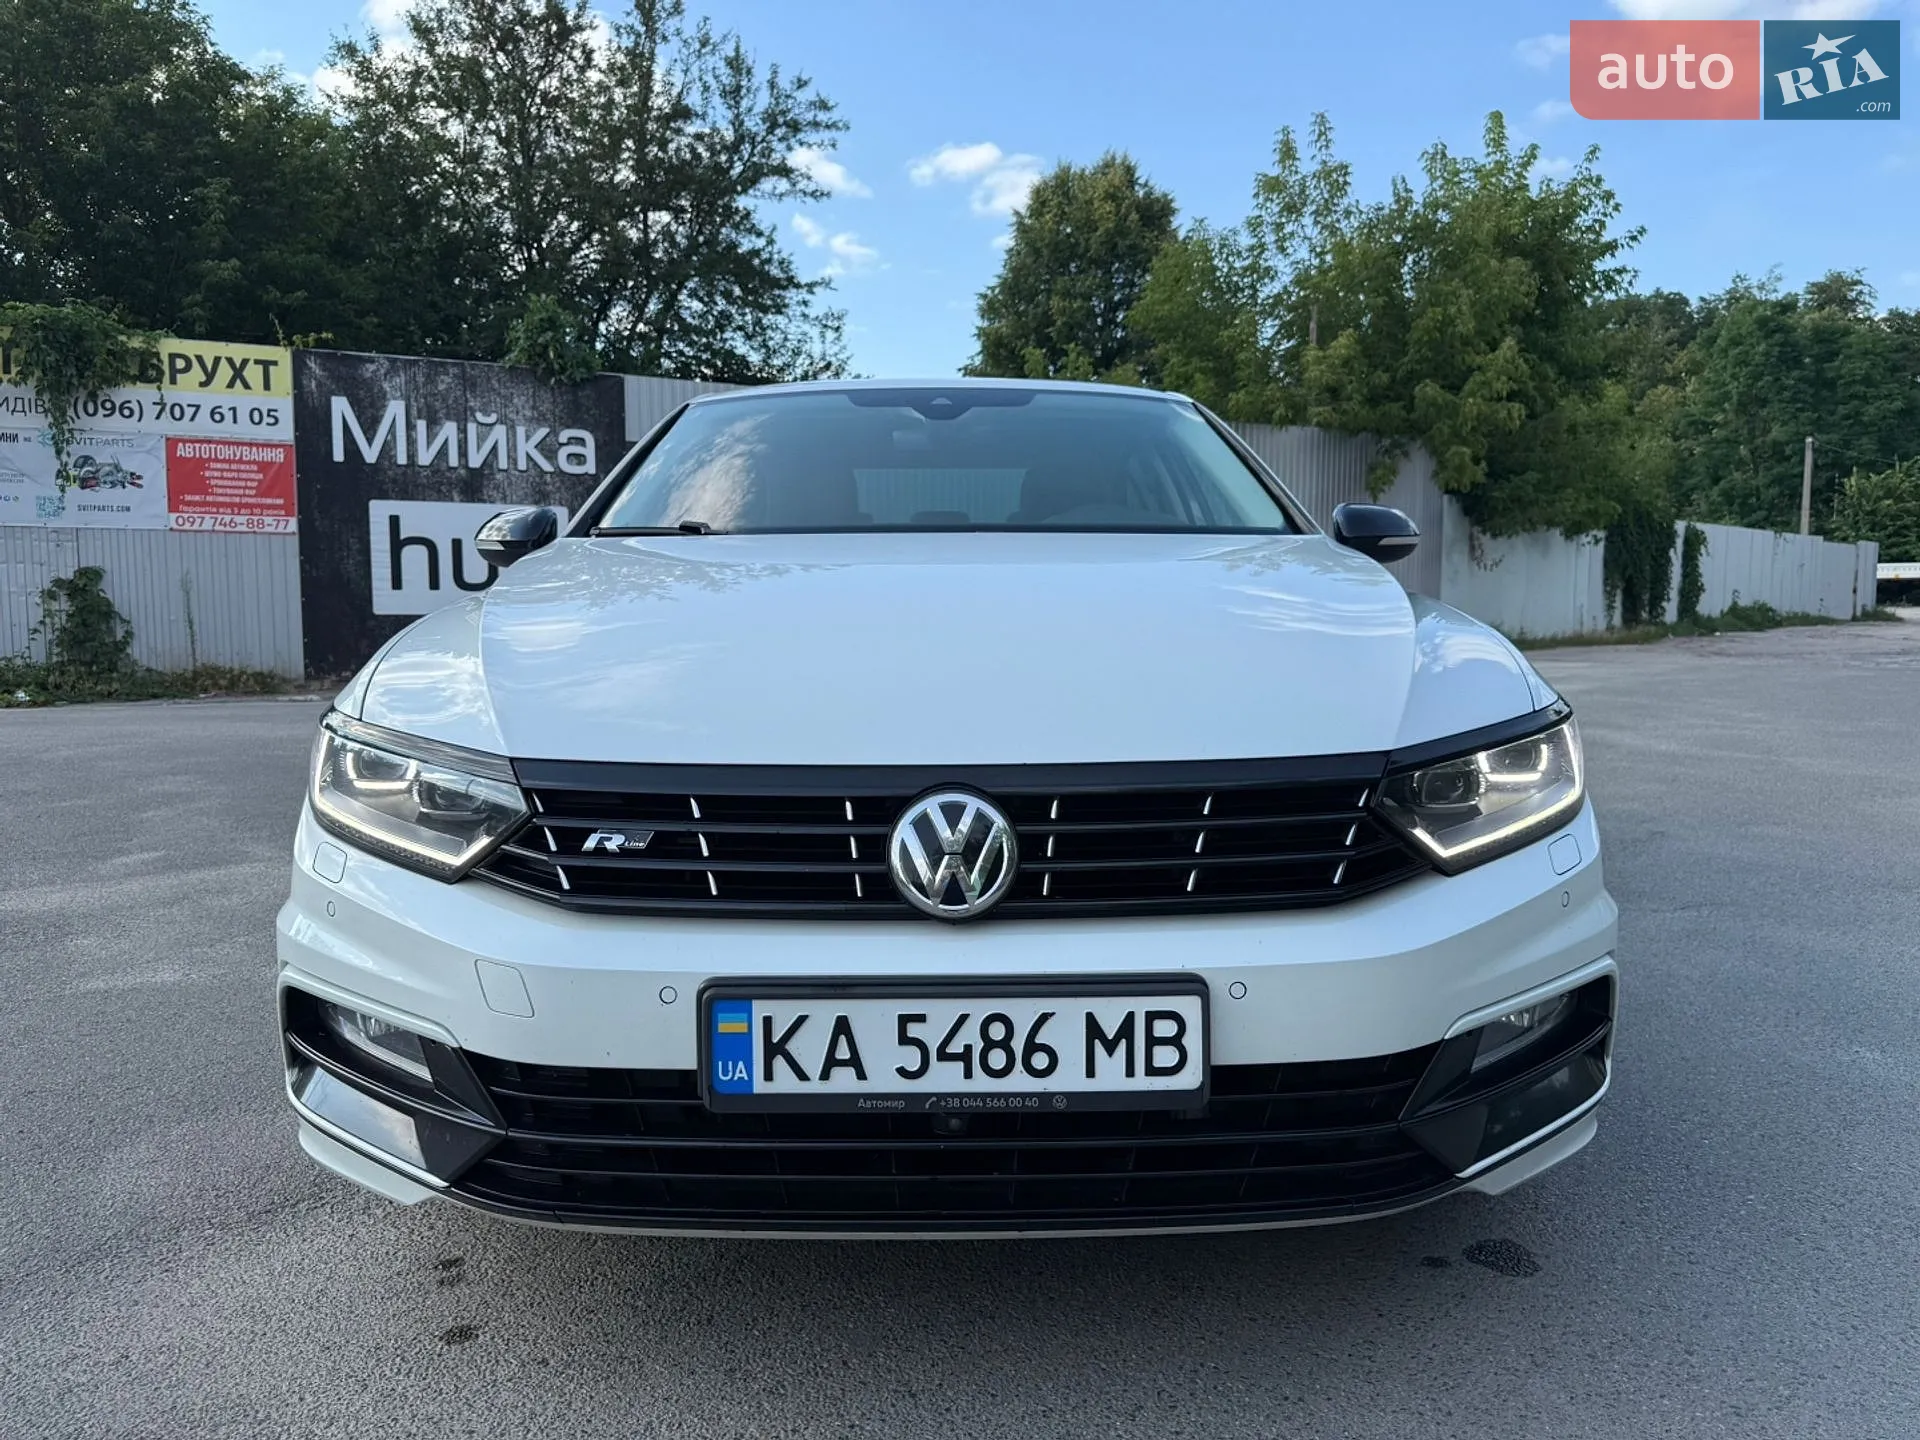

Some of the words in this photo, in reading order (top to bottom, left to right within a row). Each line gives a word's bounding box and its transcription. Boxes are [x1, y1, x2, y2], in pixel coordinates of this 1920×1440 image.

[73, 395, 144, 423] (096)
[152, 401, 201, 423] 707
[209, 405, 238, 425] 61
[249, 408, 280, 427] 05
[330, 395, 597, 476] Мийка
[176, 443, 284, 462] АВТОТОНУВАННЯ
[175, 515, 206, 527] 097
[210, 517, 290, 530] 746-88-77
[762, 1014, 868, 1082] KA
[894, 1012, 1060, 1080] 5486
[1084, 1010, 1188, 1078] MB
[718, 1065, 748, 1080] UA
[857, 1098, 905, 1109] Автомир
[939, 1097, 960, 1107] +38
[962, 1097, 983, 1107] 044
[985, 1097, 1006, 1107] 566
[1008, 1096, 1023, 1107] 00
[1024, 1096, 1039, 1106] 40
